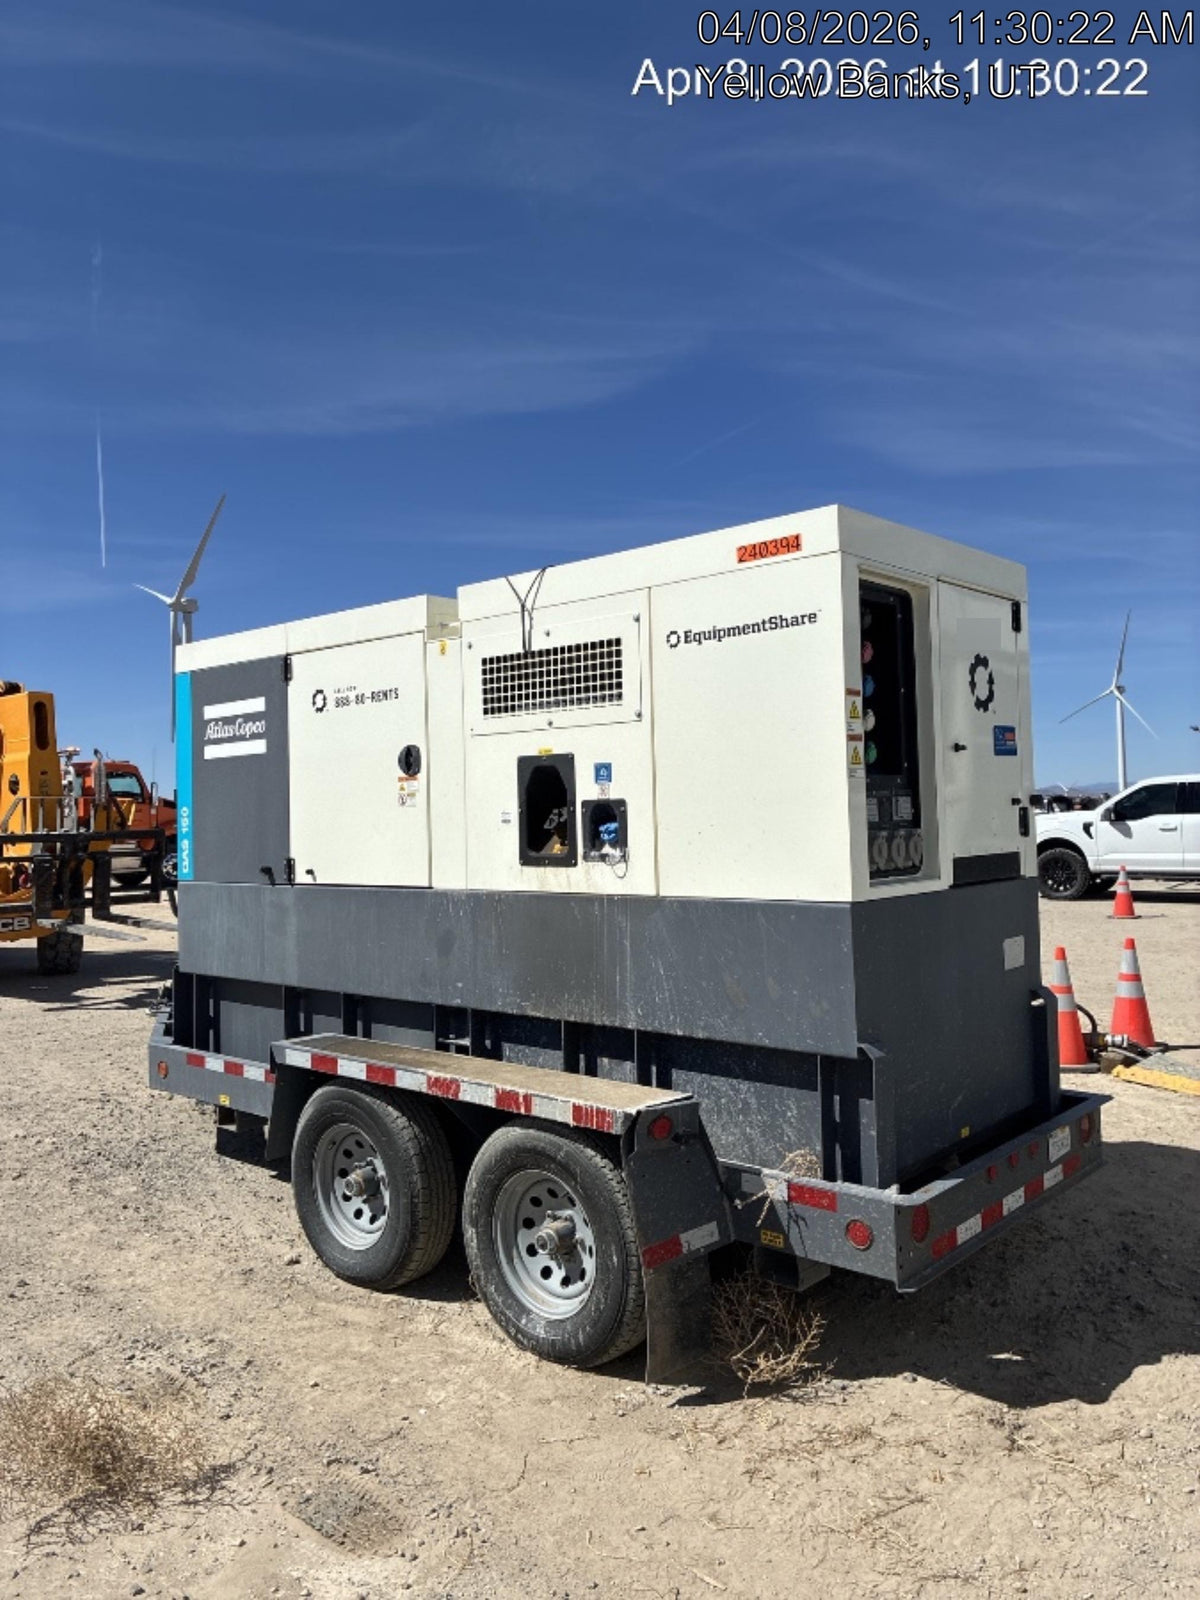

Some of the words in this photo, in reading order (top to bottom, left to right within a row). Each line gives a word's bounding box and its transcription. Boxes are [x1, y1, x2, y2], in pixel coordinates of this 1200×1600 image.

[737, 534, 801, 563] 240394
[684, 612, 818, 645] EquipmentShare
[204, 721, 234, 740] Atlas
